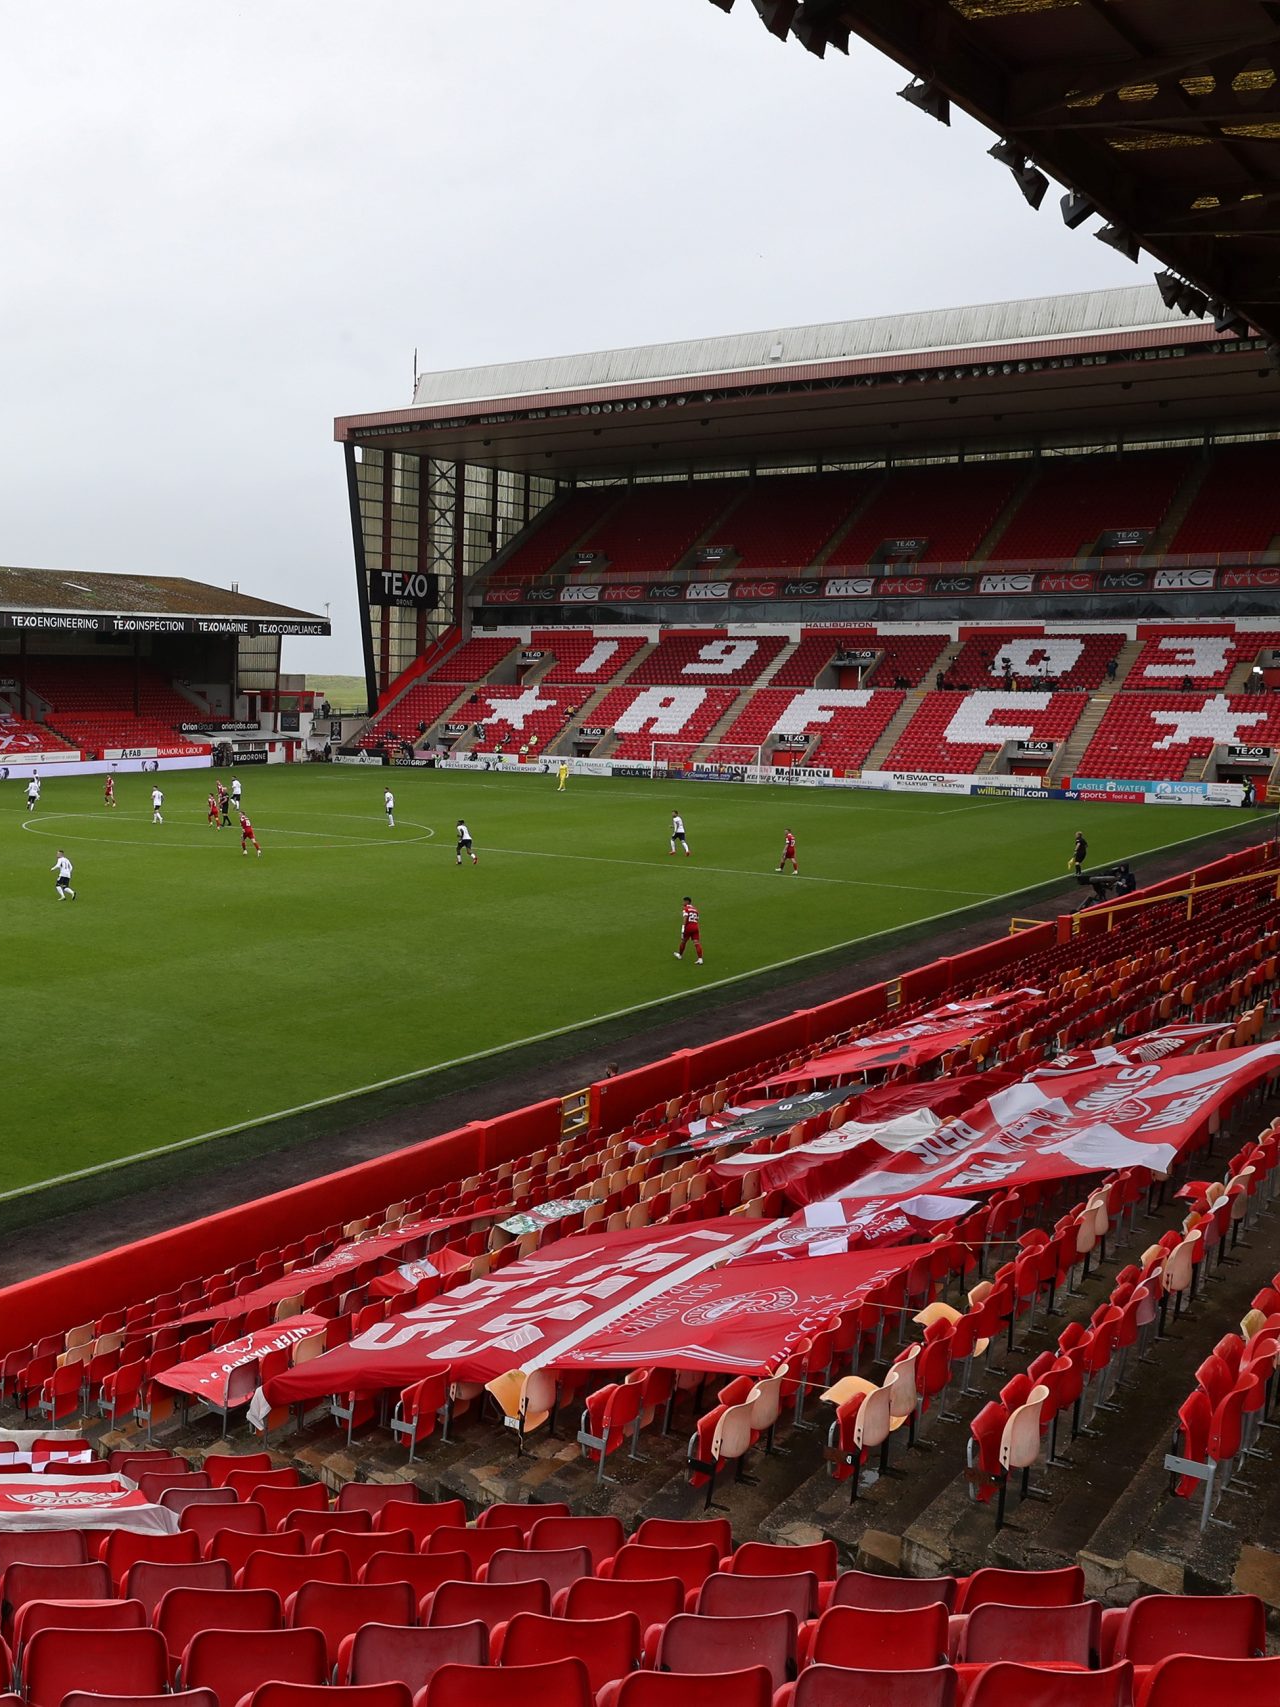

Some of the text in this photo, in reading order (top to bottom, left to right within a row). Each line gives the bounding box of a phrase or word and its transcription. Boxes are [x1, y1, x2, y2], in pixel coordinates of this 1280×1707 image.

[381, 571, 428, 598] TEXO
[12, 615, 99, 630] TEXO ENGINEERING
[113, 620, 185, 632] TEXO INSPECTION
[199, 622, 248, 633] TEXO MARINE
[259, 623, 322, 635] TEXO COMPLIANCE
[221, 722, 258, 730] orionjobs.com
[783, 735, 805, 743] TEXO
[1023, 741, 1048, 749] TEXO
[157, 748, 185, 756] BALMORAL
[1235, 747, 1263, 755] TEXO
[395, 758, 427, 766] SCOTGRIP
[977, 786, 1048, 798] williamhill.com
[1117, 784, 1145, 792] WATER
[1174, 785, 1203, 793] KORE
[1064, 790, 1078, 799] sky
[1080, 791, 1107, 799] sports
[1075, 1063, 1160, 1112] STAND
[665, 1281, 722, 1310] SOUL
